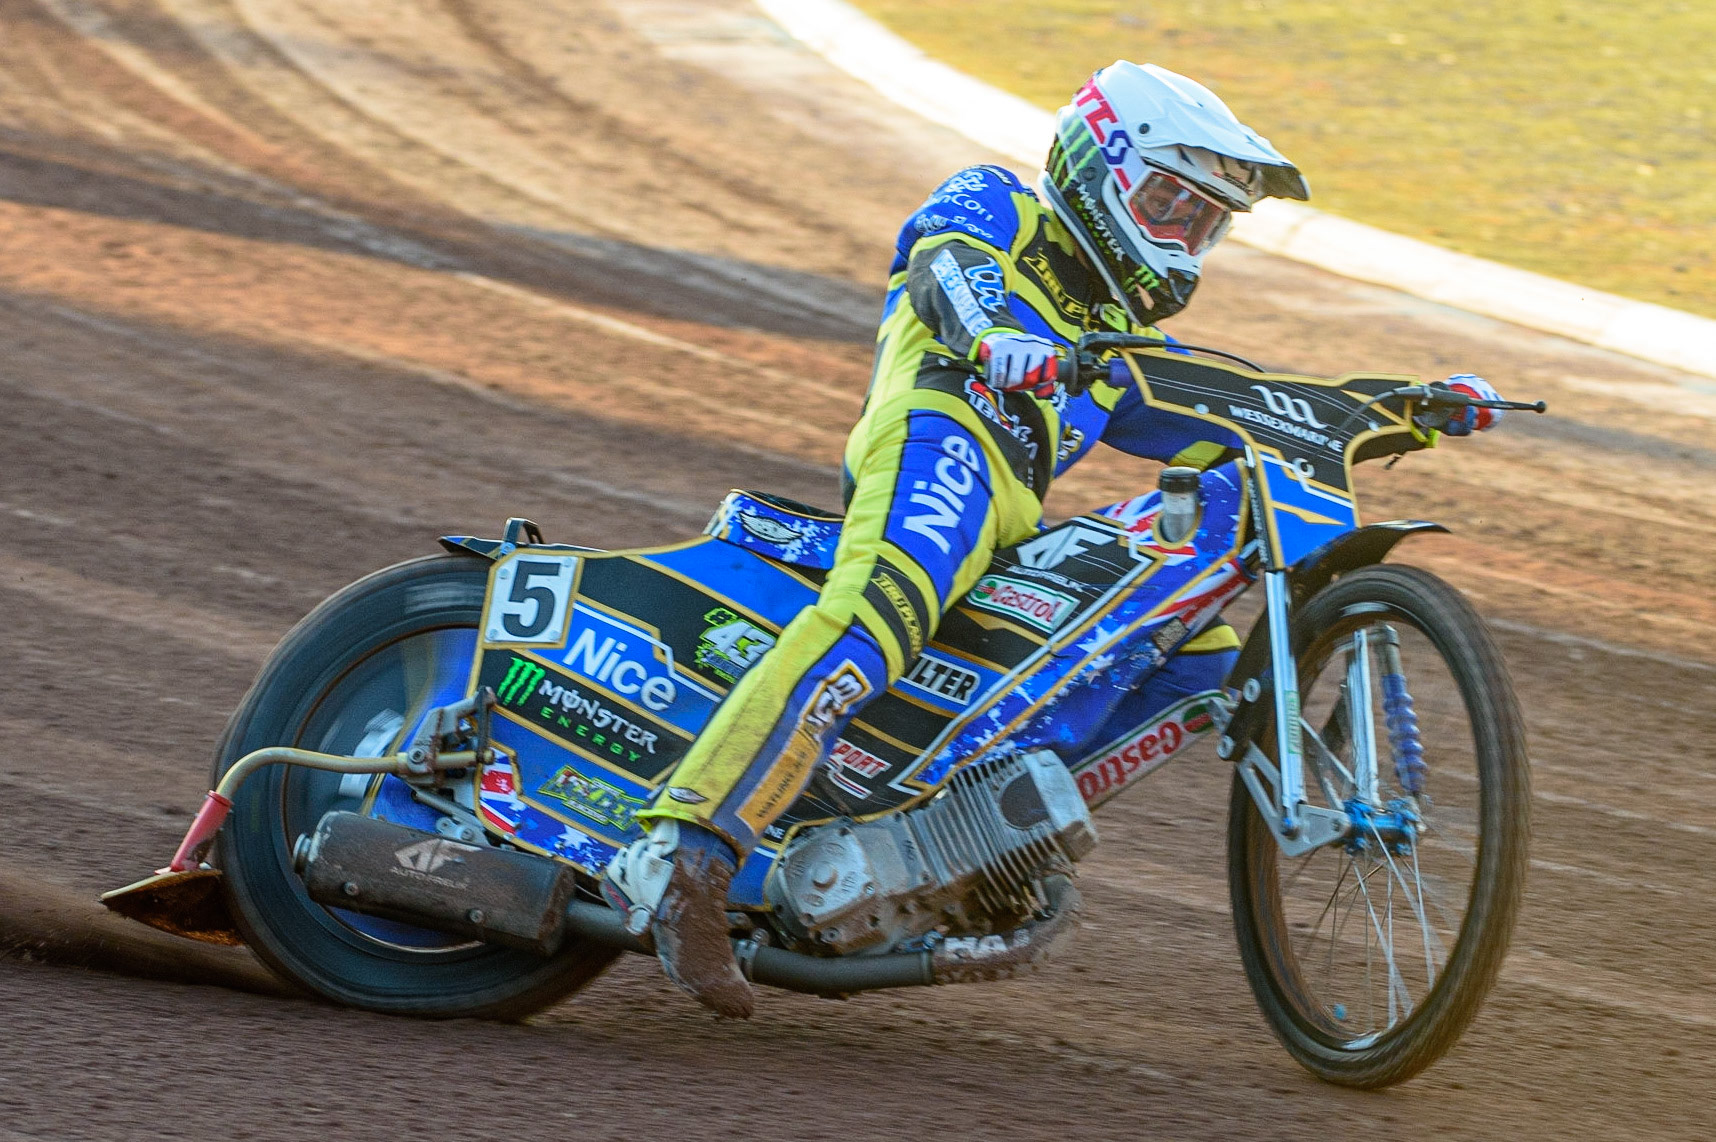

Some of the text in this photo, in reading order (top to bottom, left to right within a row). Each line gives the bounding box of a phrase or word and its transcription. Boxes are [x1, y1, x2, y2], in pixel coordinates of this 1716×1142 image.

[902, 435, 980, 555] Nice
[502, 560, 561, 638] 5
[991, 585, 1062, 622] Castrol
[562, 628, 677, 711] Nice
[539, 679, 659, 754] MONSTER
[541, 707, 642, 763] ENERGY
